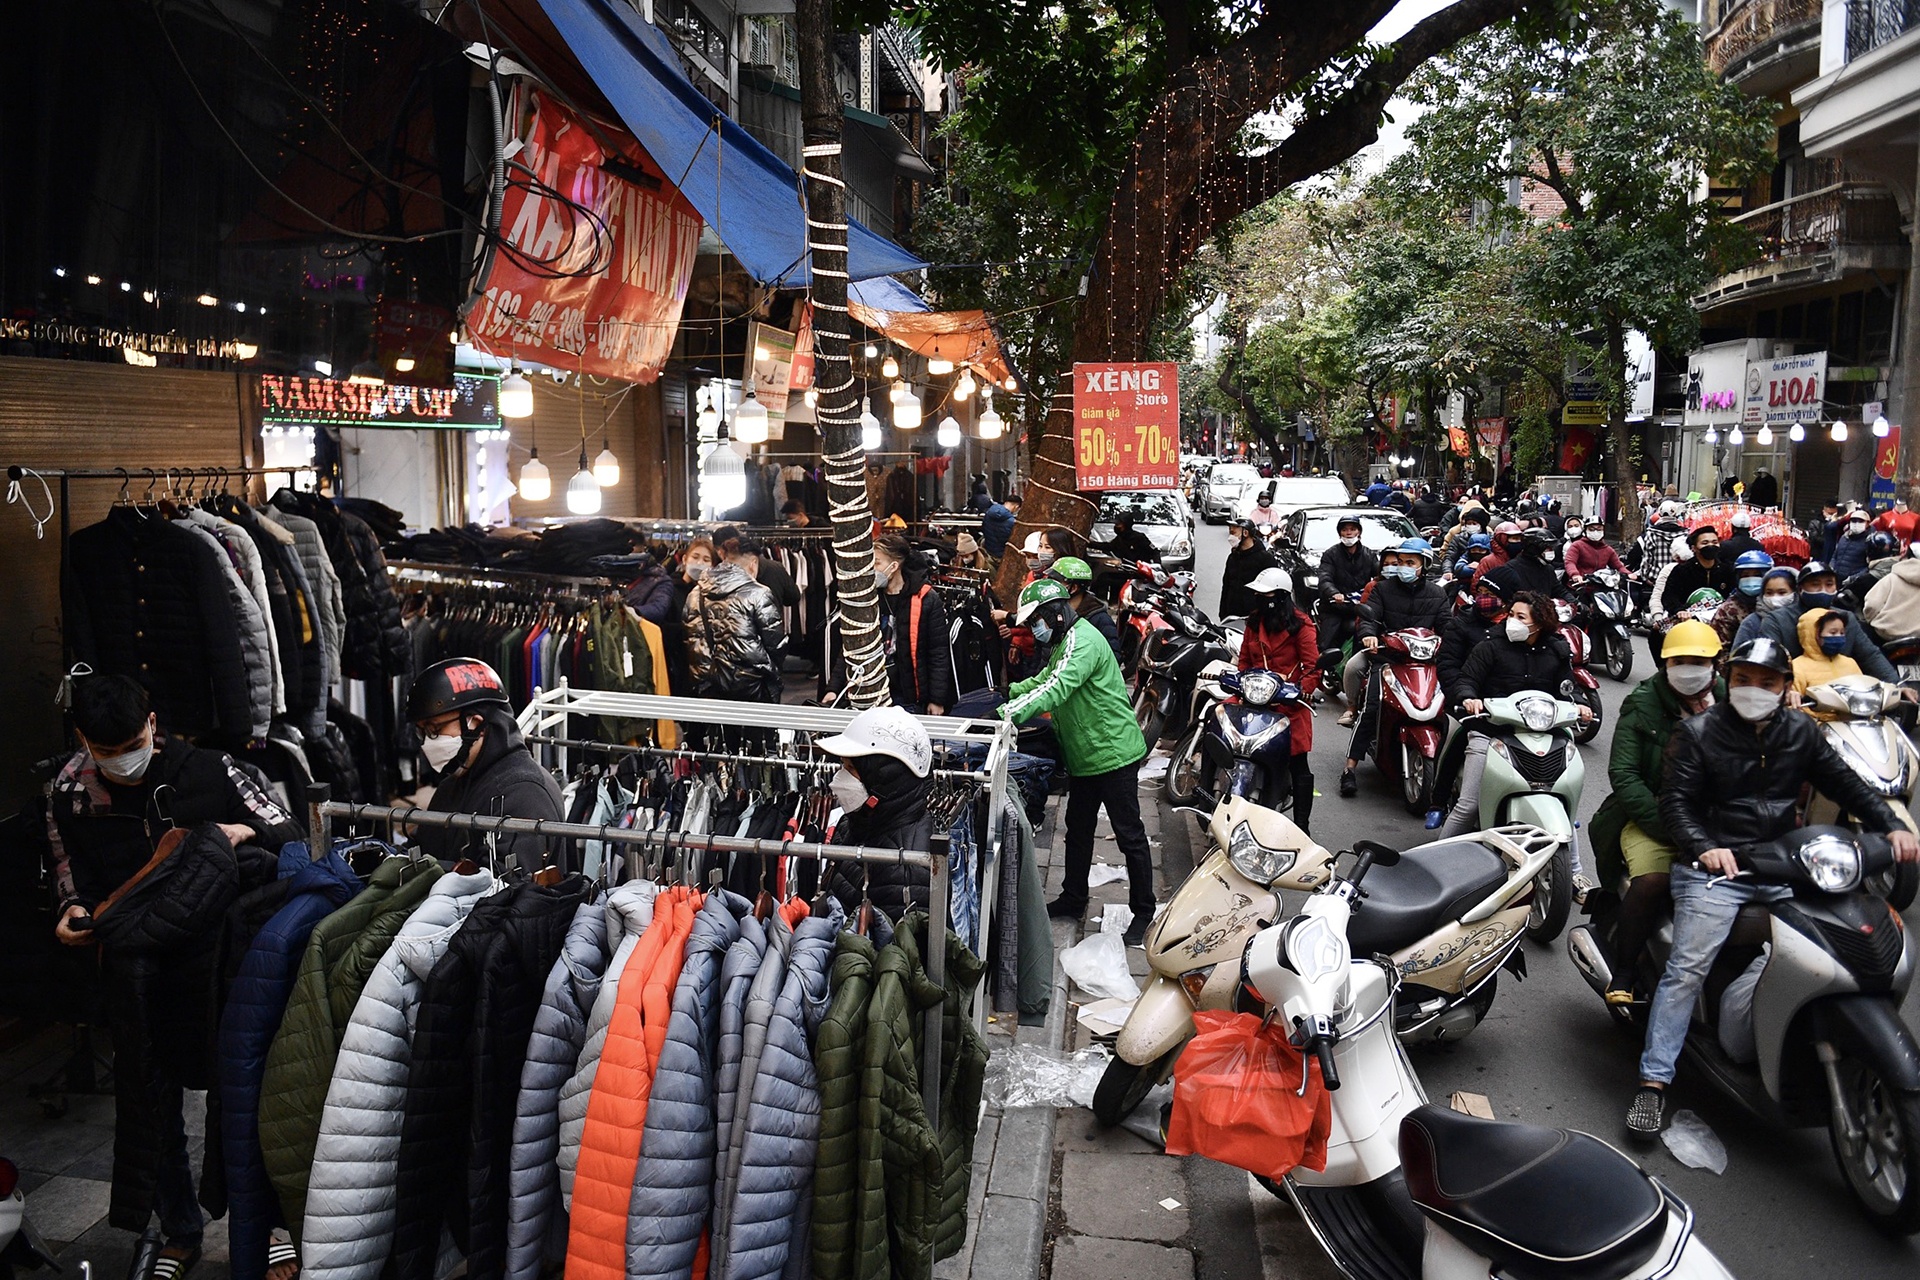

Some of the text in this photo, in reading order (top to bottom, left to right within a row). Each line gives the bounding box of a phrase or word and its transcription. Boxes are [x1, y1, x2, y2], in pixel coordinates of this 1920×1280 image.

[622, 185, 672, 298] NAM
[1080, 427, 1120, 467] 50%
[1135, 425, 1175, 464] 70%
[1082, 474, 1174, 487] 150 Hàng Bông
